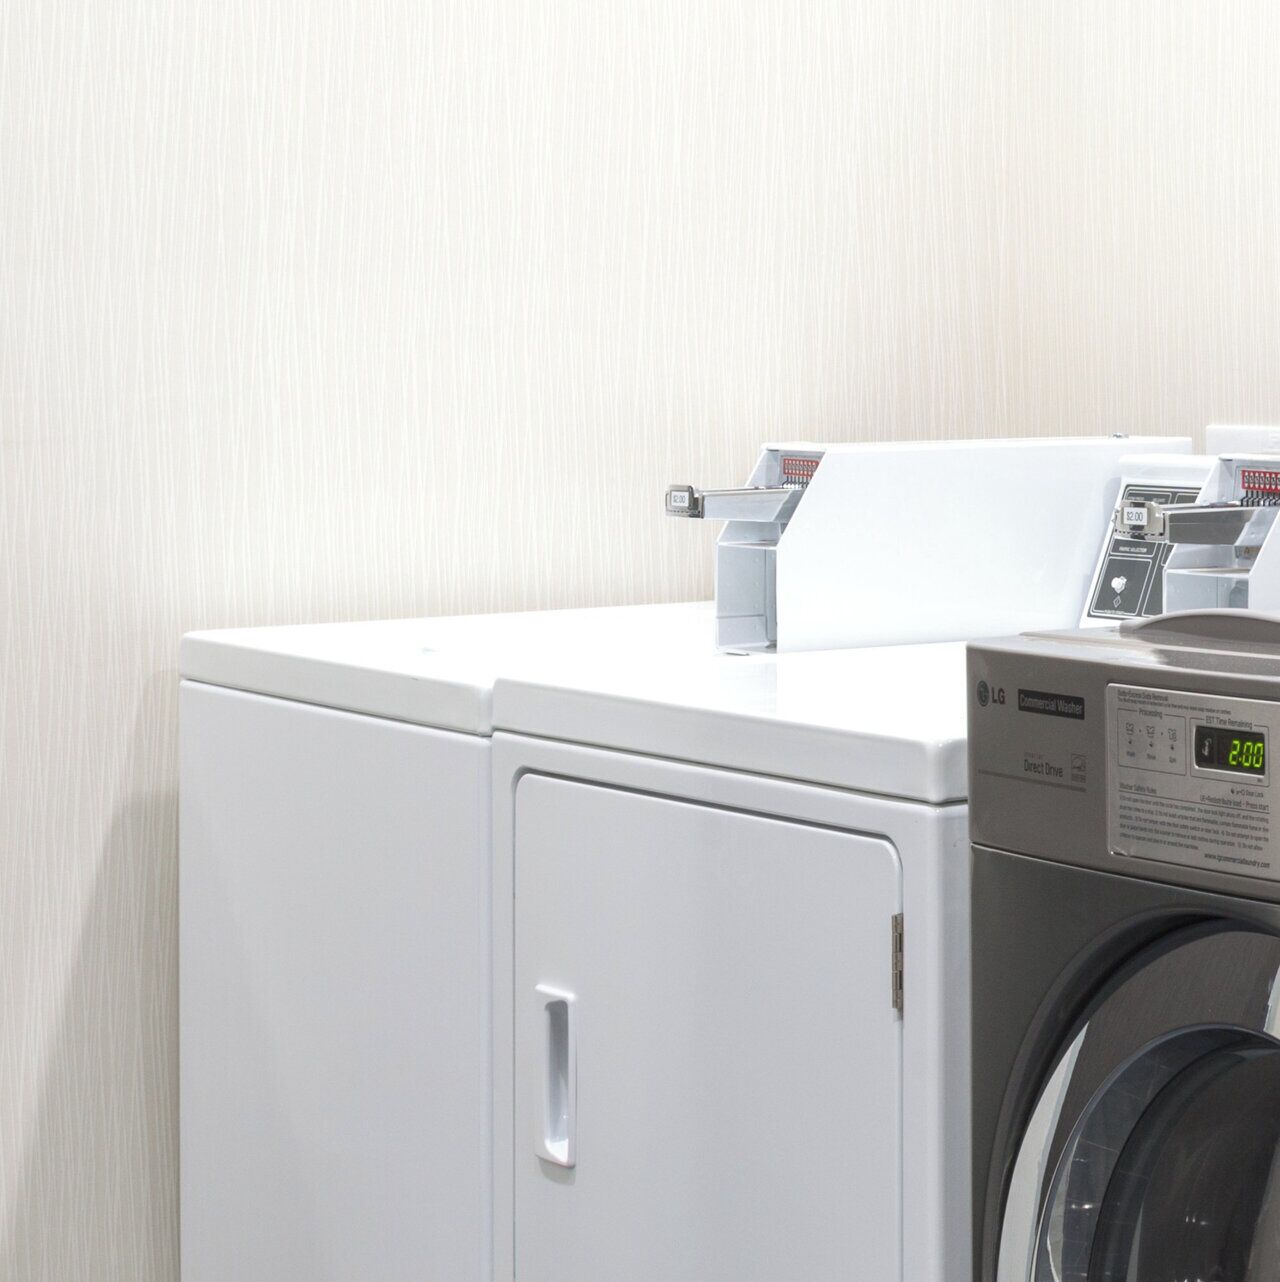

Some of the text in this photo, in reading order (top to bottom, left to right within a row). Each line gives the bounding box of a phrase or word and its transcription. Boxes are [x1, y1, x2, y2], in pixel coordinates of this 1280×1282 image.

[1126, 511, 1144, 522] $2.00
[991, 687, 1005, 704] LG
[1020, 694, 1082, 714] Commercial Washer
[1024, 759, 1063, 777] Direct Drive
